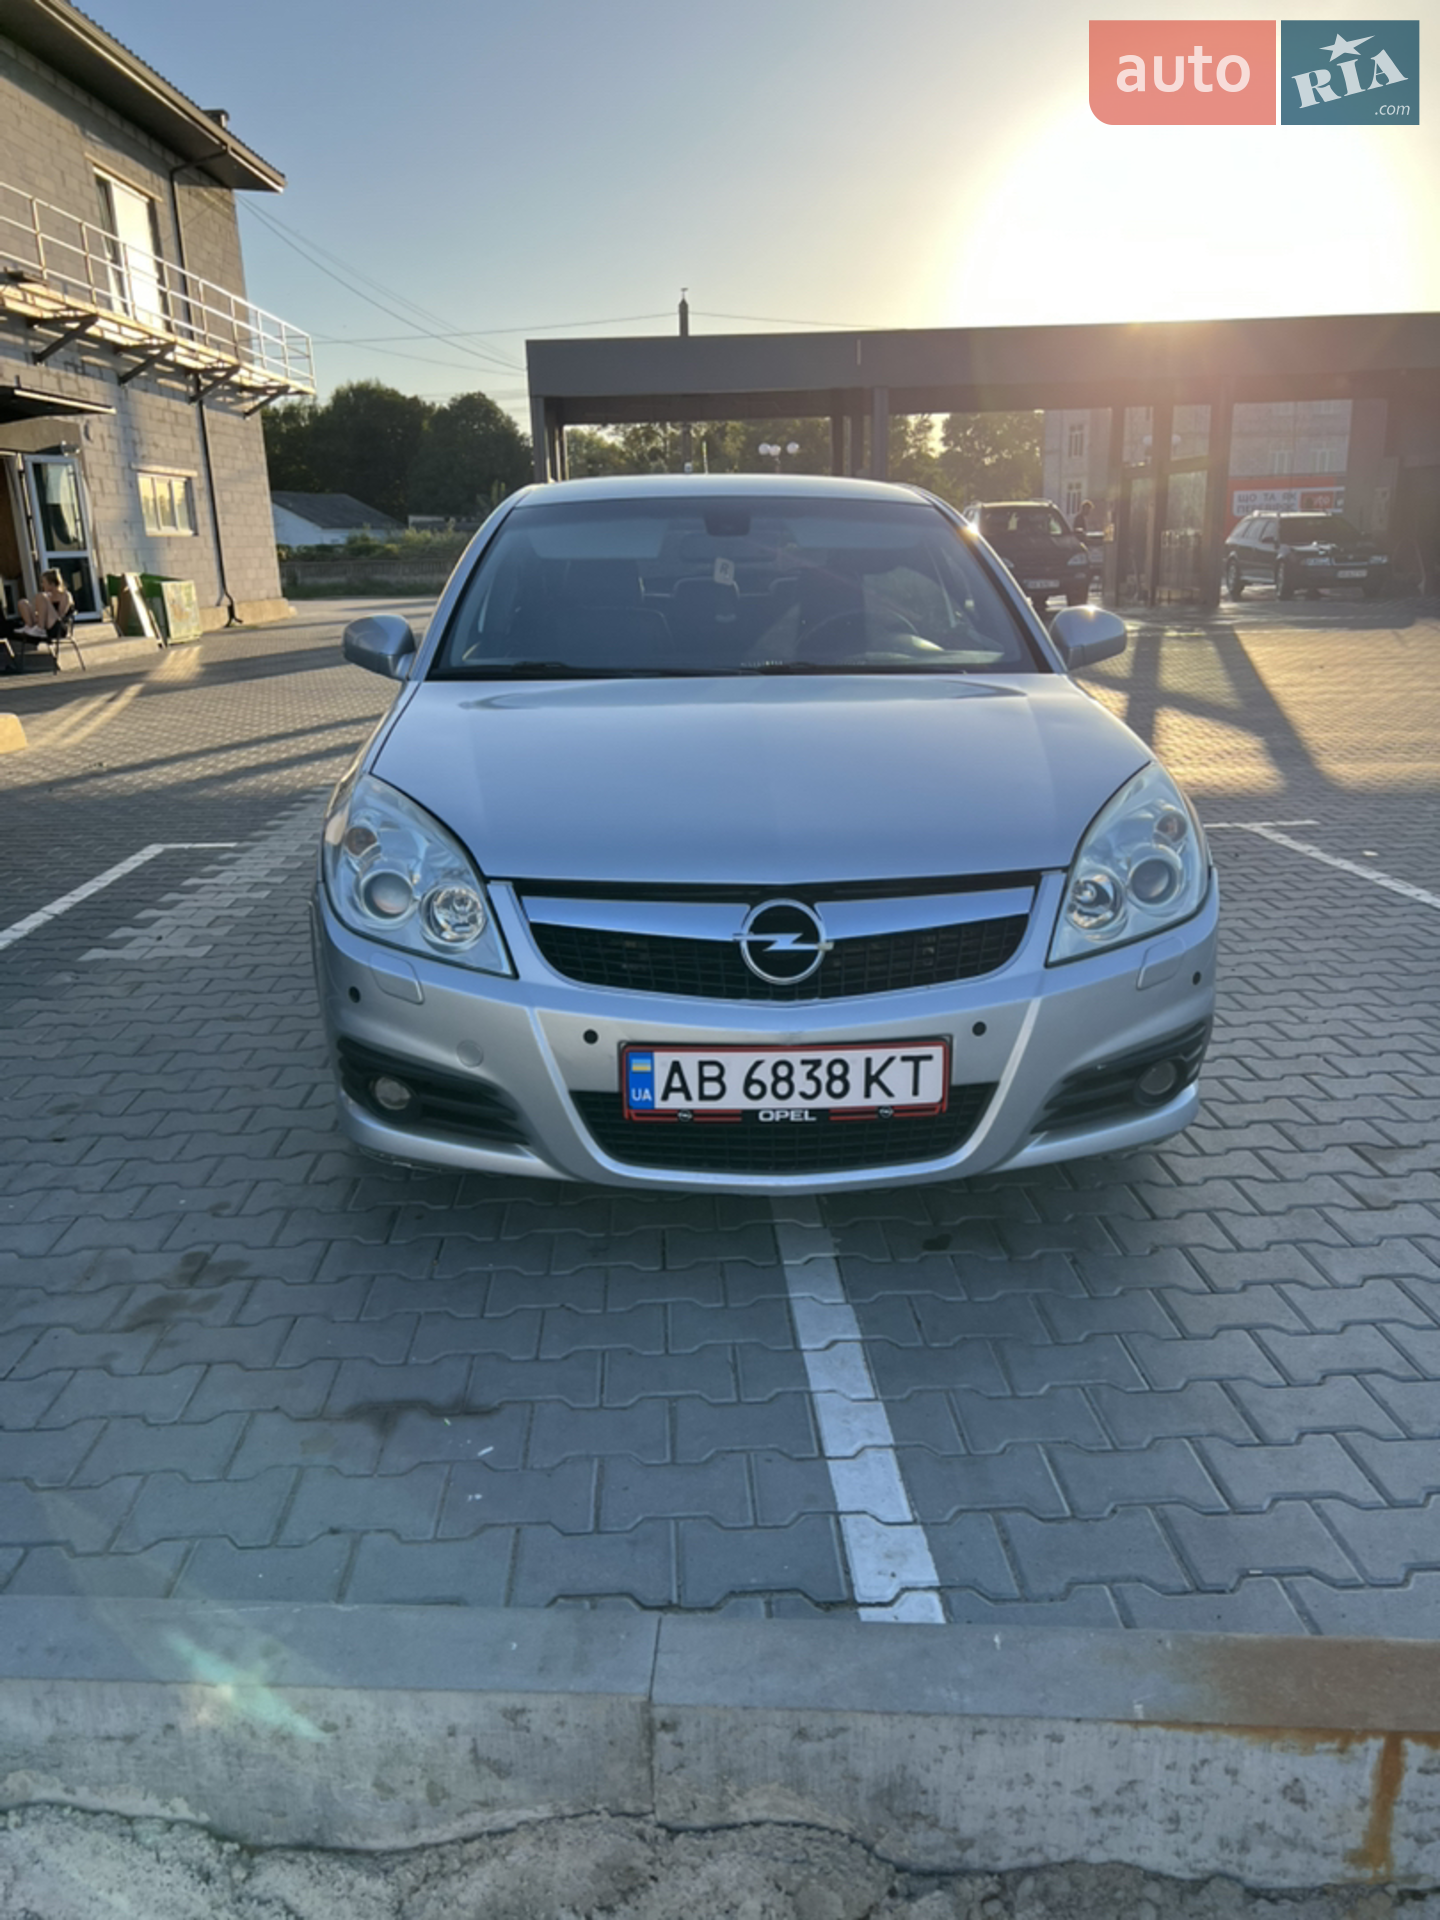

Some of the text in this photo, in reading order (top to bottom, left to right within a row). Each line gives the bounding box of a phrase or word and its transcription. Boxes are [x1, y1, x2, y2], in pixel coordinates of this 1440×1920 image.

[660, 1054, 934, 1102] AB 6838 KT
[631, 1088, 653, 1102] UA
[758, 1110, 817, 1123] OPEL
